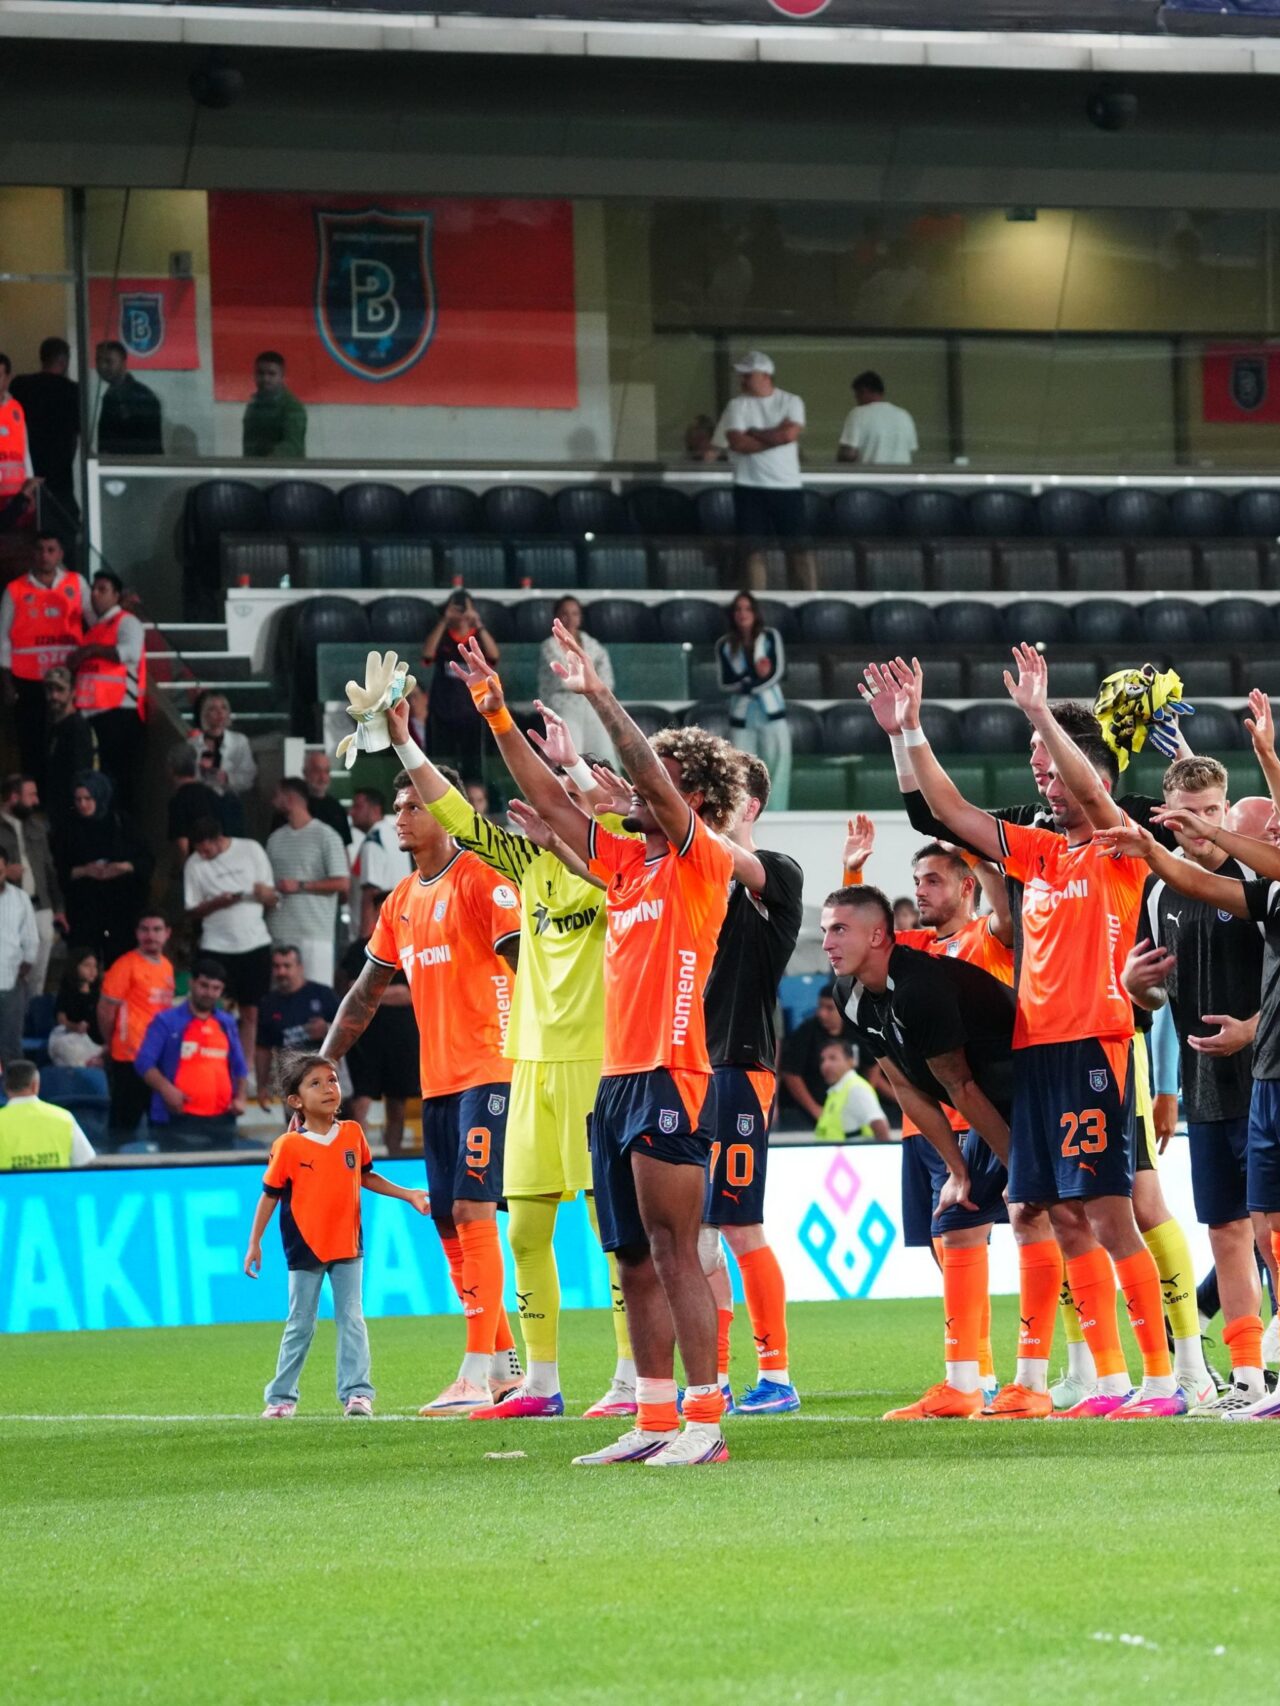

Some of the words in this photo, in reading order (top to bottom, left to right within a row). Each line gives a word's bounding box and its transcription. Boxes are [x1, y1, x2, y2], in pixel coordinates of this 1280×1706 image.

[351, 259, 400, 338] B
[553, 905, 600, 934] TODIN
[671, 949, 697, 1046] Homend
[466, 1127, 491, 1167] 9
[1060, 1109, 1108, 1158] 23
[0, 1190, 242, 1332] AKIF
